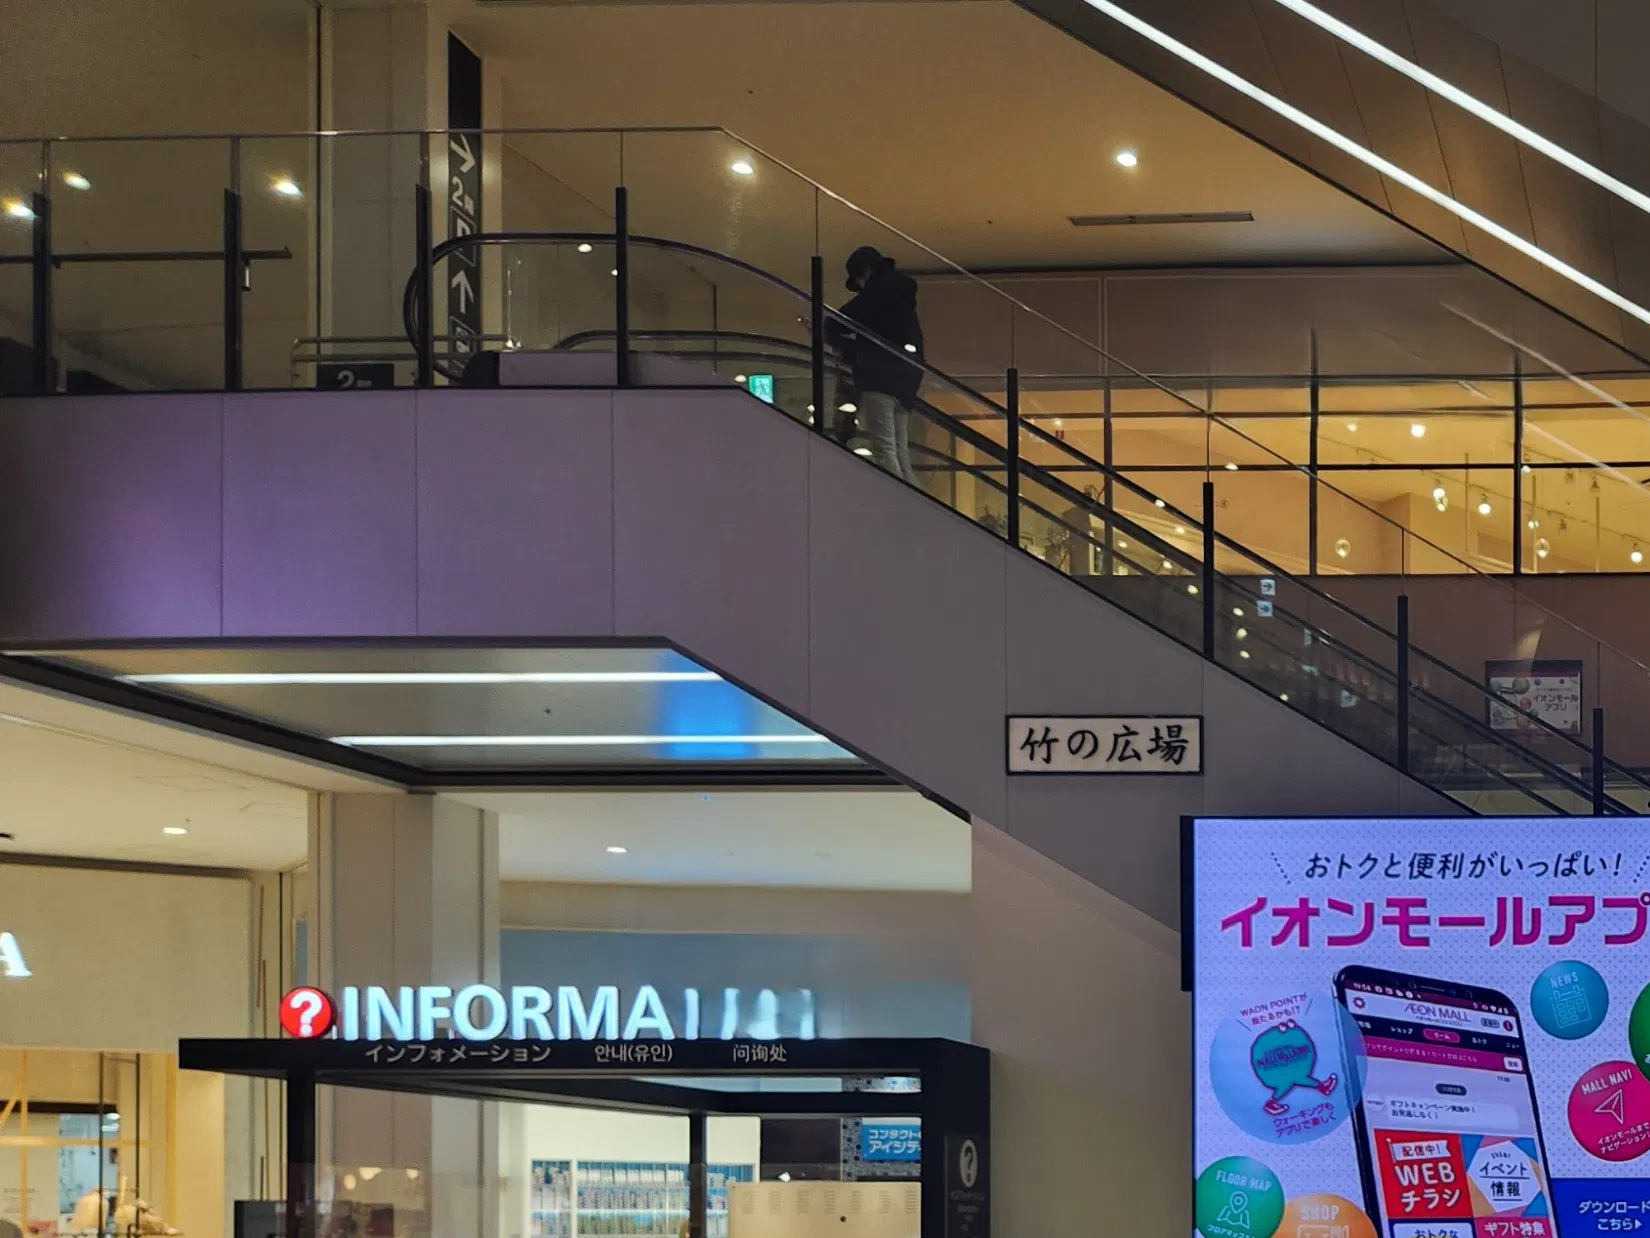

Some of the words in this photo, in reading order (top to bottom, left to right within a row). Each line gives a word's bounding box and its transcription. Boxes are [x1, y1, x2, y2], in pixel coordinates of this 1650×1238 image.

[1020, 725, 1189, 765] 竹の広場
[1305, 852, 1622, 880] おトクと便利がいっぱい!
[1550, 971, 1578, 989] NEWS
[1438, 1008, 1472, 1022] MALL
[366, 1044, 551, 1063] インフォメーション
[594, 1044, 673, 1063] 안내(유인)
[733, 1044, 787, 1063] 问询处
[1581, 1078, 1608, 1095] MALL
[1609, 1069, 1632, 1086] NAVI
[1401, 1143, 1442, 1157] 配信中!
[1394, 1161, 1455, 1187] WEB
[1479, 1162, 1528, 1176] イベント
[1215, 1169, 1247, 1187] FLOOR
[1249, 1178, 1272, 1192] MAP
[1490, 1180, 1521, 1197] 情報
[1401, 1188, 1460, 1213] チラシ
[1302, 1205, 1339, 1220] SHOP
[1484, 1220, 1546, 1237] ギフト特集
[1597, 1218, 1633, 1231] こちら
